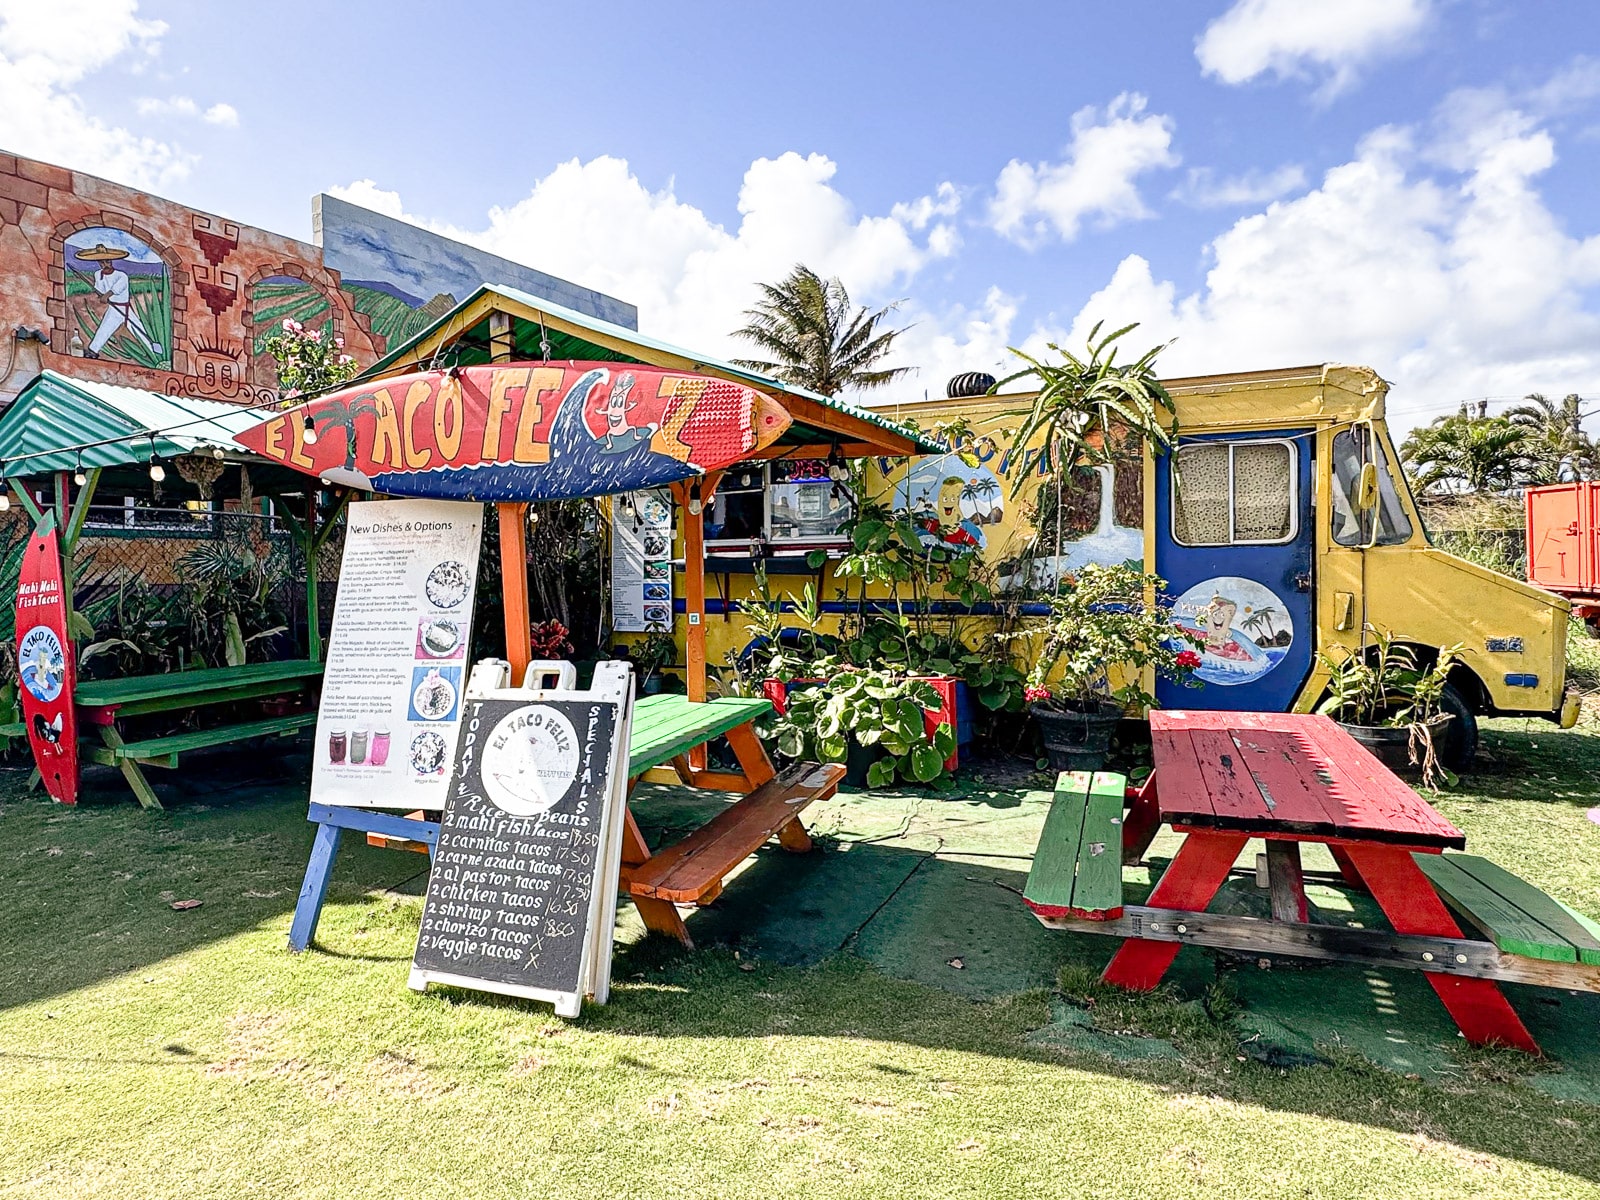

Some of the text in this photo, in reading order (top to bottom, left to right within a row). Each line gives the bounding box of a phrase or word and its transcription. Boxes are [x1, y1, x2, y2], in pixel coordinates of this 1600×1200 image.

[266, 405, 315, 469] EL
[350, 521, 453, 534] New Dishes & Options
[19, 580, 58, 594] Mahi Mahi
[19, 594, 59, 608] Fish Tacos
[27, 631, 45, 647] TACO
[23, 648, 32, 658] EL
[493, 713, 570, 753] EL TACO FELIZ
[576, 706, 601, 815] SPECIALS
[444, 813, 455, 827] 2
[455, 815, 496, 832] mahi
[495, 818, 532, 838] fish
[531, 821, 570, 840] tacos
[538, 809, 590, 827] Beans
[436, 850, 445, 862] 2
[529, 858, 562, 875] tacos
[441, 833, 591, 866] 2 carnitas tacos 17.50
[432, 866, 442, 879] 2
[444, 865, 460, 881] al
[460, 870, 512, 888] pastor
[514, 875, 552, 891] tacos
[430, 883, 439, 895] 2
[440, 882, 498, 904] chicken
[501, 891, 543, 908] tacos
[427, 902, 437, 914] 2
[438, 901, 492, 926] shrimp
[496, 909, 541, 927] tacos
[423, 918, 433, 930] 2
[434, 917, 488, 938] chorizo
[490, 927, 533, 945] tacos
[420, 935, 430, 948] 2
[480, 941, 523, 960] tacos
